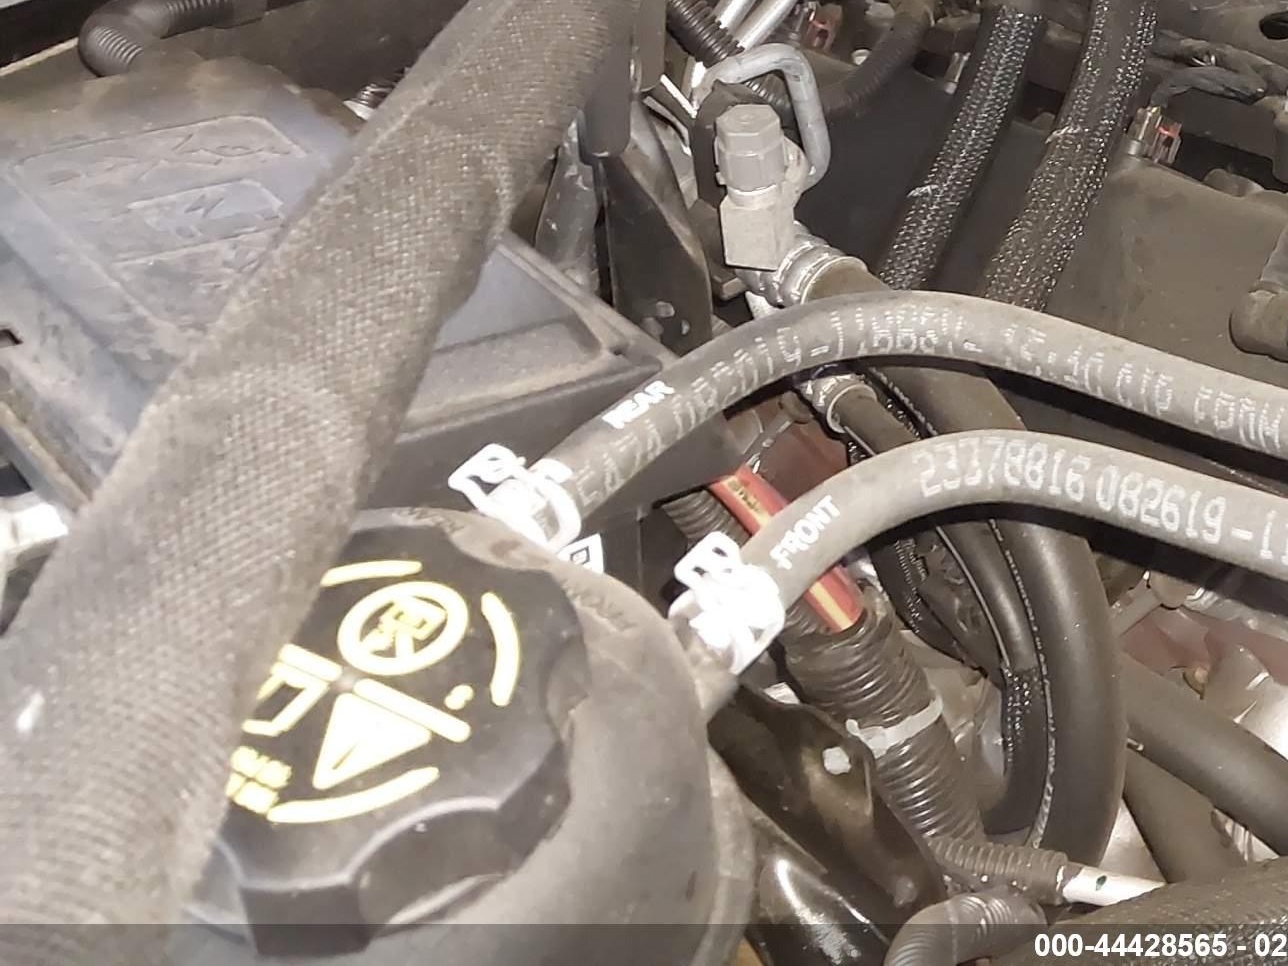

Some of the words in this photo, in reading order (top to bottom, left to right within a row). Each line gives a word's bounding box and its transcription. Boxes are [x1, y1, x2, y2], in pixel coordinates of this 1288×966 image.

[601, 379, 675, 430] REAR
[911, 436, 1092, 503] 23378816
[769, 494, 841, 570] FRONT
